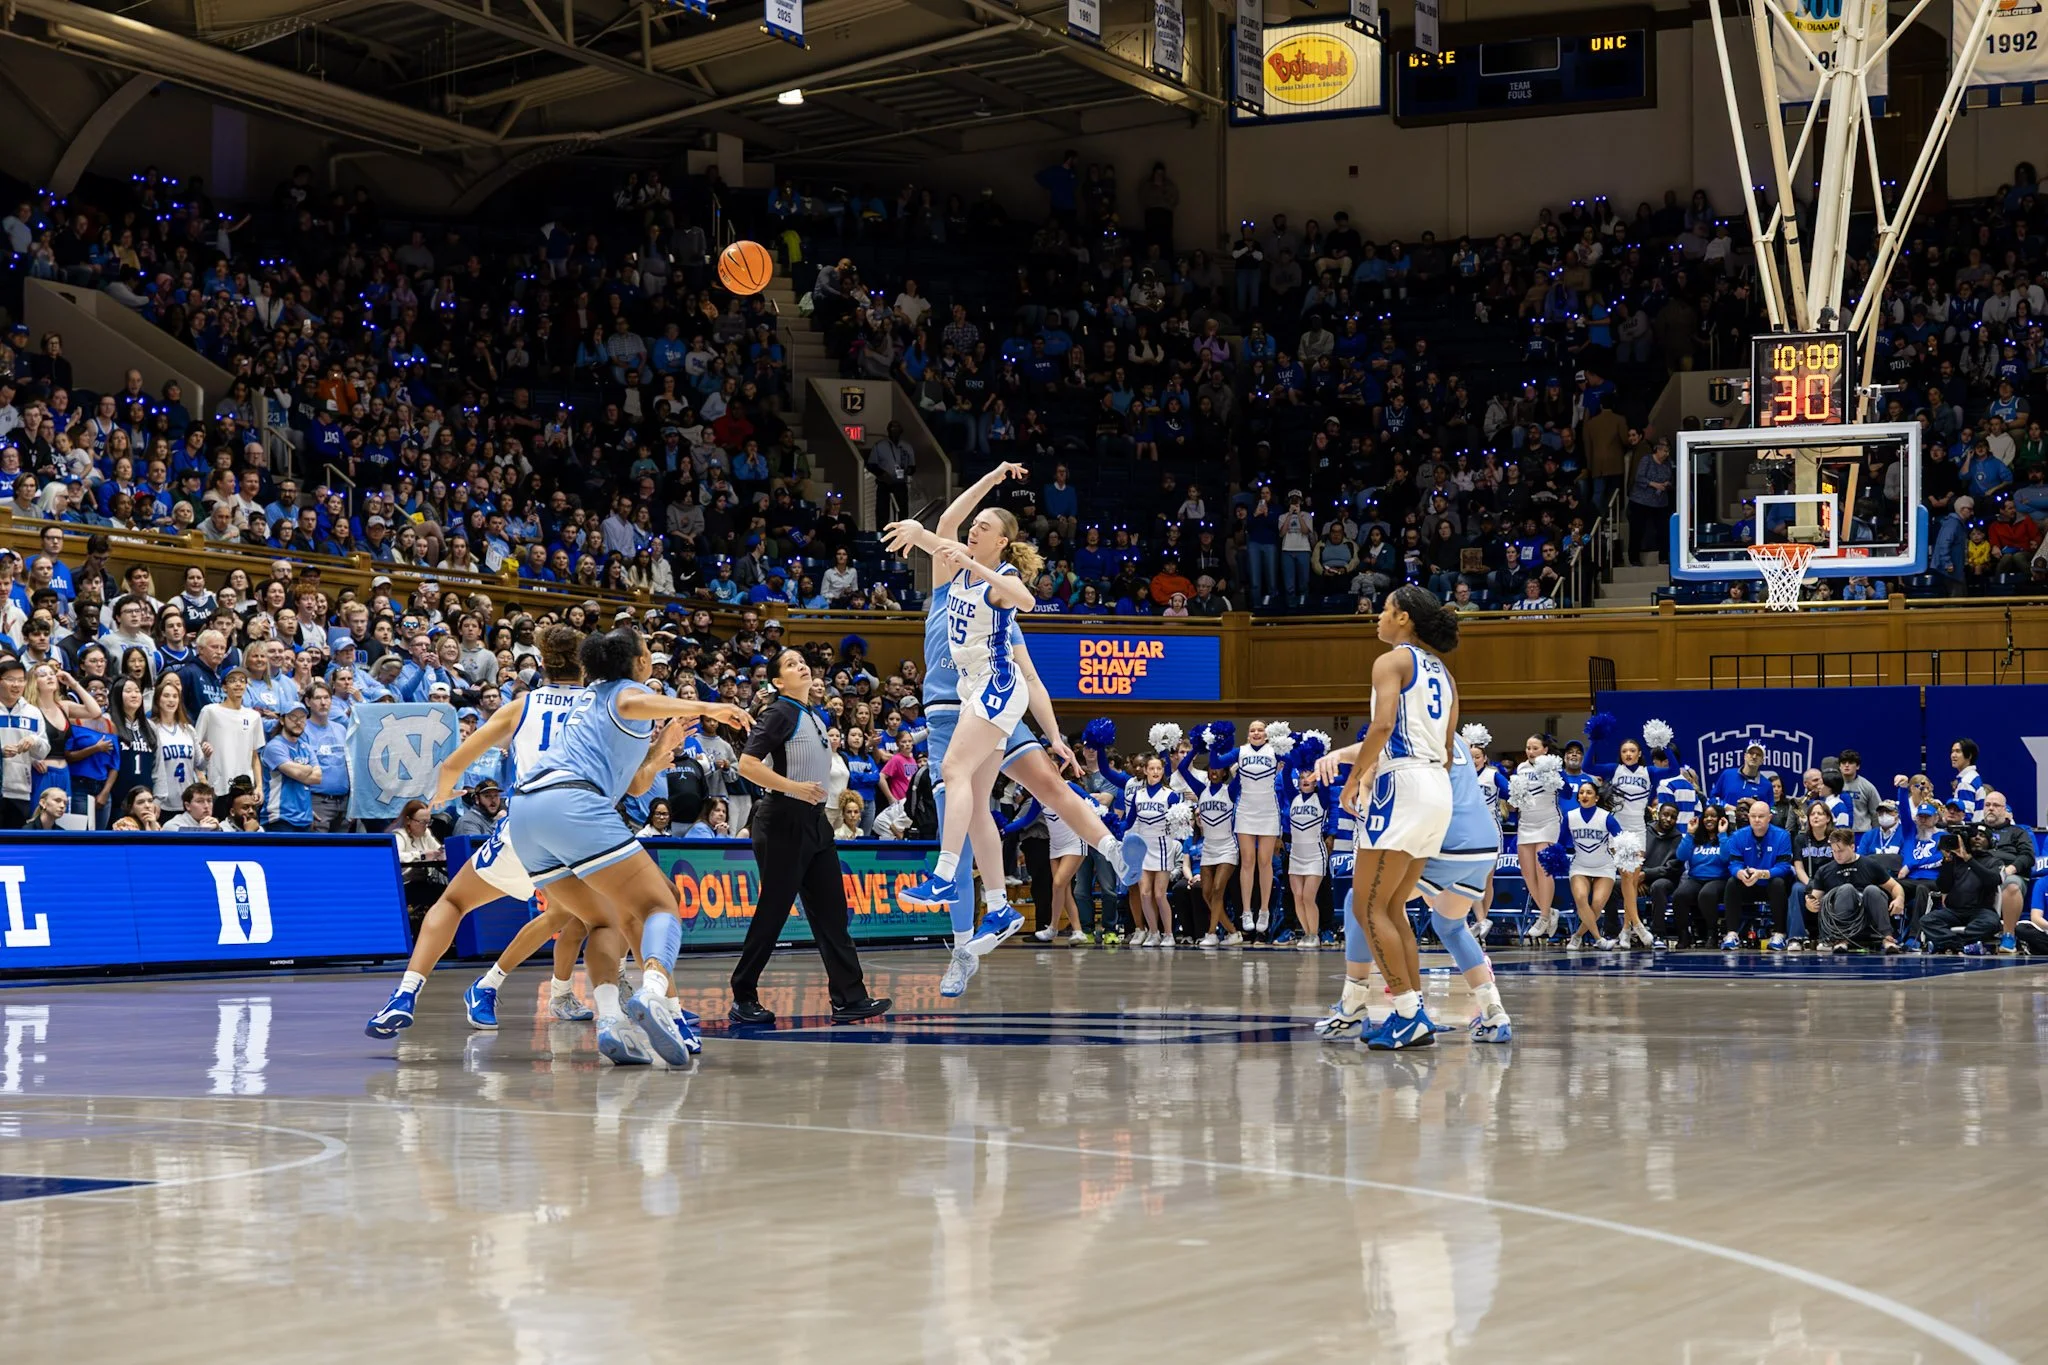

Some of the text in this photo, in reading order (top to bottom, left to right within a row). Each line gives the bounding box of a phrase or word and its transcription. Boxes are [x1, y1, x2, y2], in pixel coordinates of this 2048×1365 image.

[777, 8, 791, 23] 2025
[1079, 9, 1092, 24] 1991
[1797, 21, 1840, 32] INDIANAP
[1591, 36, 1627, 51] UNC
[1986, 31, 2037, 53] 1992
[1805, 51, 1837, 71] 199
[1509, 81, 1530, 91] TEAM
[1507, 90, 1532, 100] FOULS
[1774, 343, 1839, 371] 10:00
[846, 395, 862, 410] 12
[1774, 374, 1830, 422] 30
[1034, 603, 1061, 613] DUKE
[1079, 640, 1164, 659] DOLLAR
[1079, 659, 1148, 677] SHAVE
[536, 693, 573, 707] THOM
[1427, 677, 1442, 720] 3
[566, 692, 597, 726] 2
[163, 744, 194, 761] DUKE
[134, 754, 141, 775] 1
[1242, 755, 1273, 768] DUKE
[1709, 750, 1803, 775] SISTHOOD
[174, 762, 186, 783] 4
[1617, 776, 1648, 788] DUKE
[1136, 801, 1165, 813] DUKE
[1200, 801, 1228, 812] DUKE
[1290, 805, 1318, 817] DUKE
[1369, 814, 1386, 831] D
[1573, 829, 1604, 840] DUKE
[1497, 856, 1521, 869] DUK
[2036, 857, 2048, 871] DU
[841, 873, 891, 915] AVE
